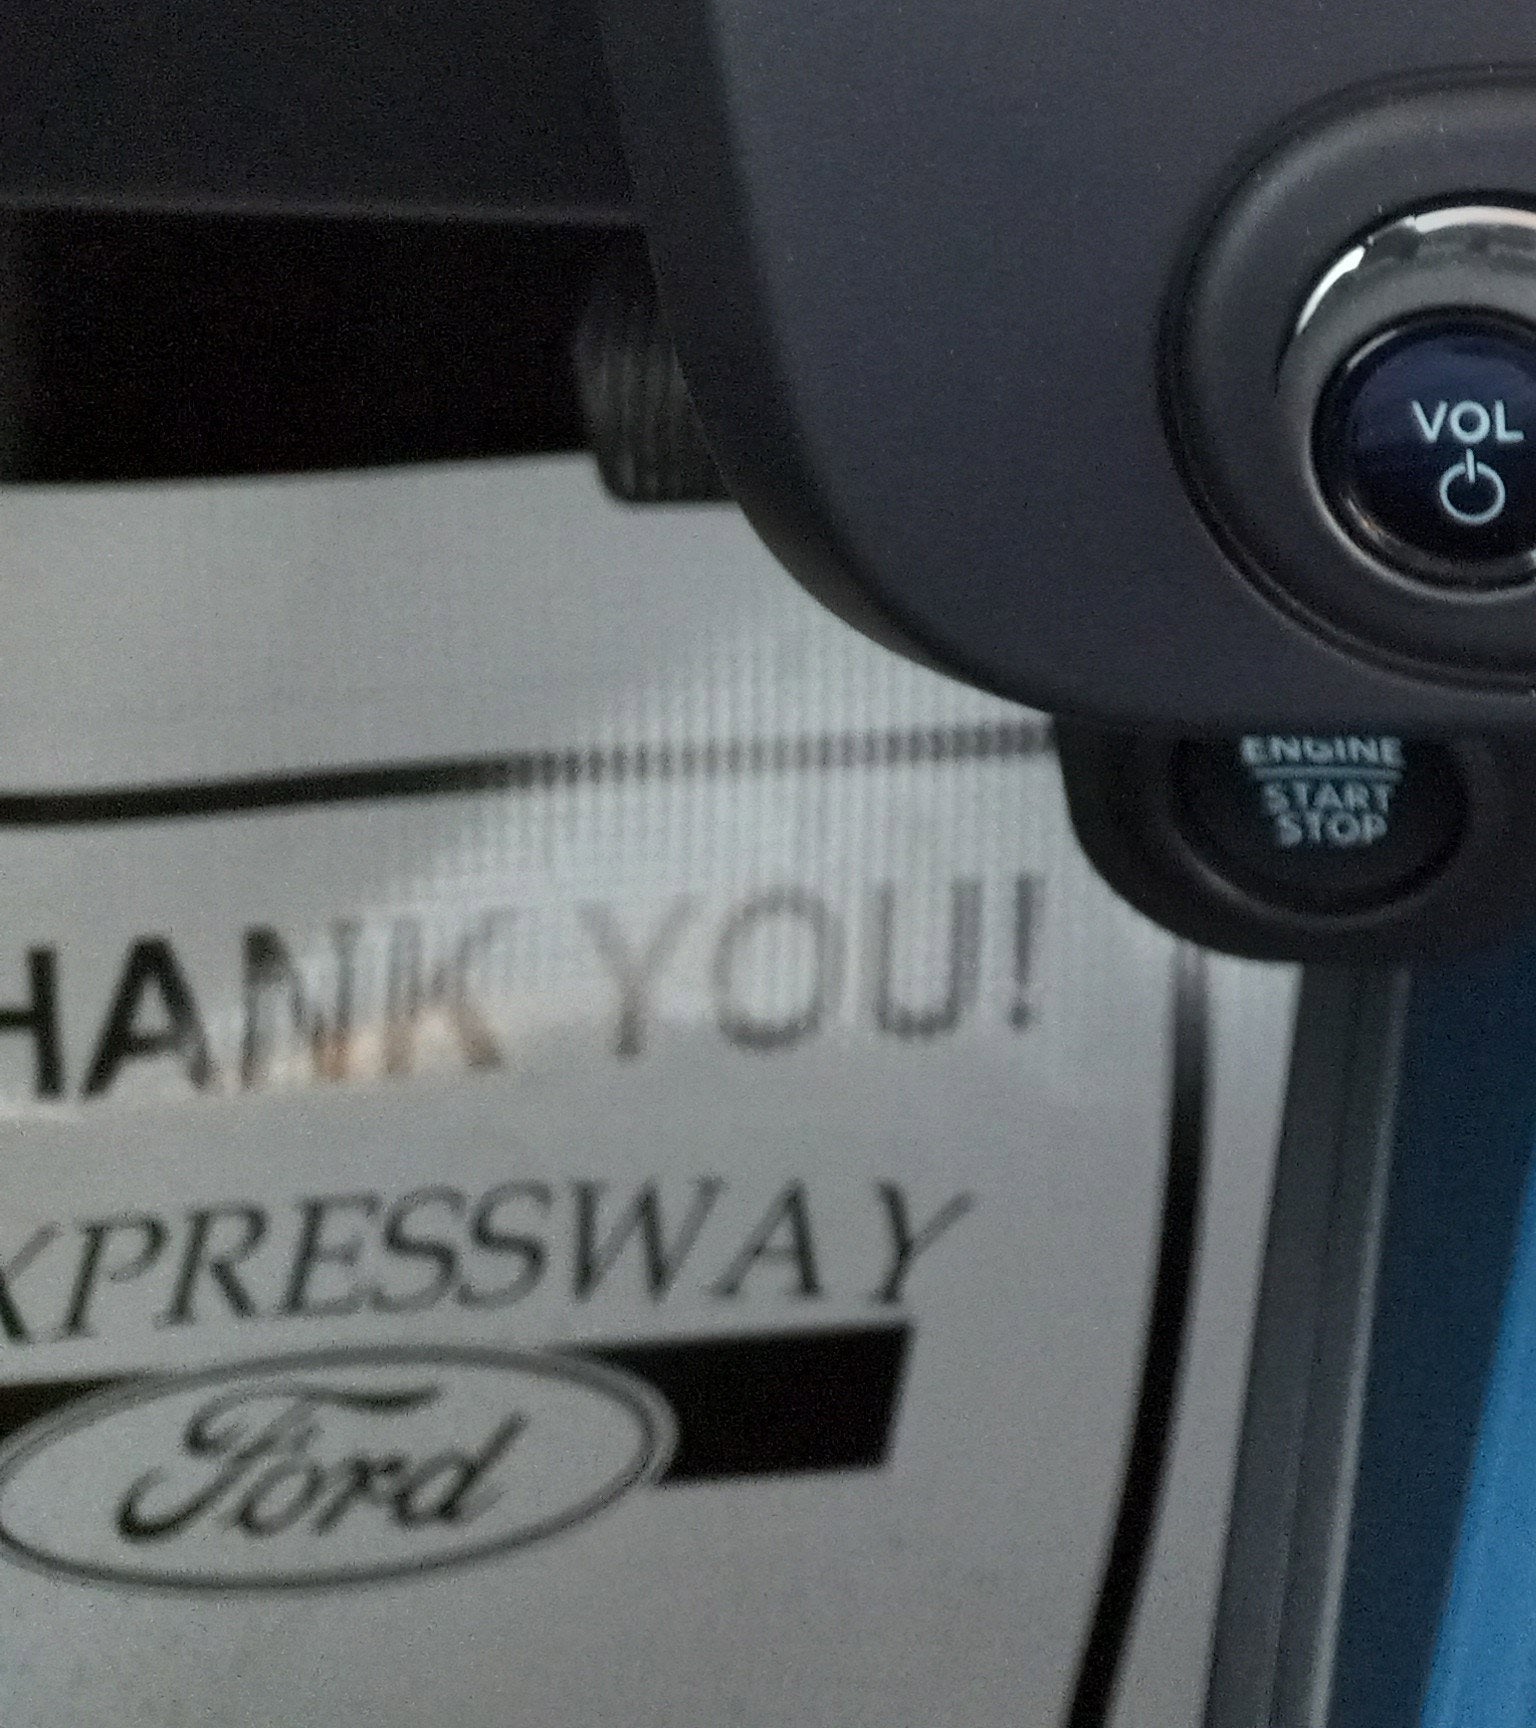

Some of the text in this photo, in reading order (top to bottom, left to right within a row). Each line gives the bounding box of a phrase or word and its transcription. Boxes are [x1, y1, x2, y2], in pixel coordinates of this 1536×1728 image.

[1411, 400, 1525, 444] VOL
[1240, 735, 1404, 766] ENGINE
[1262, 782, 1392, 812] START
[1277, 811, 1388, 848] STOP
[577, 872, 1046, 1059] YOU!
[117, 1382, 525, 1544] Ford
